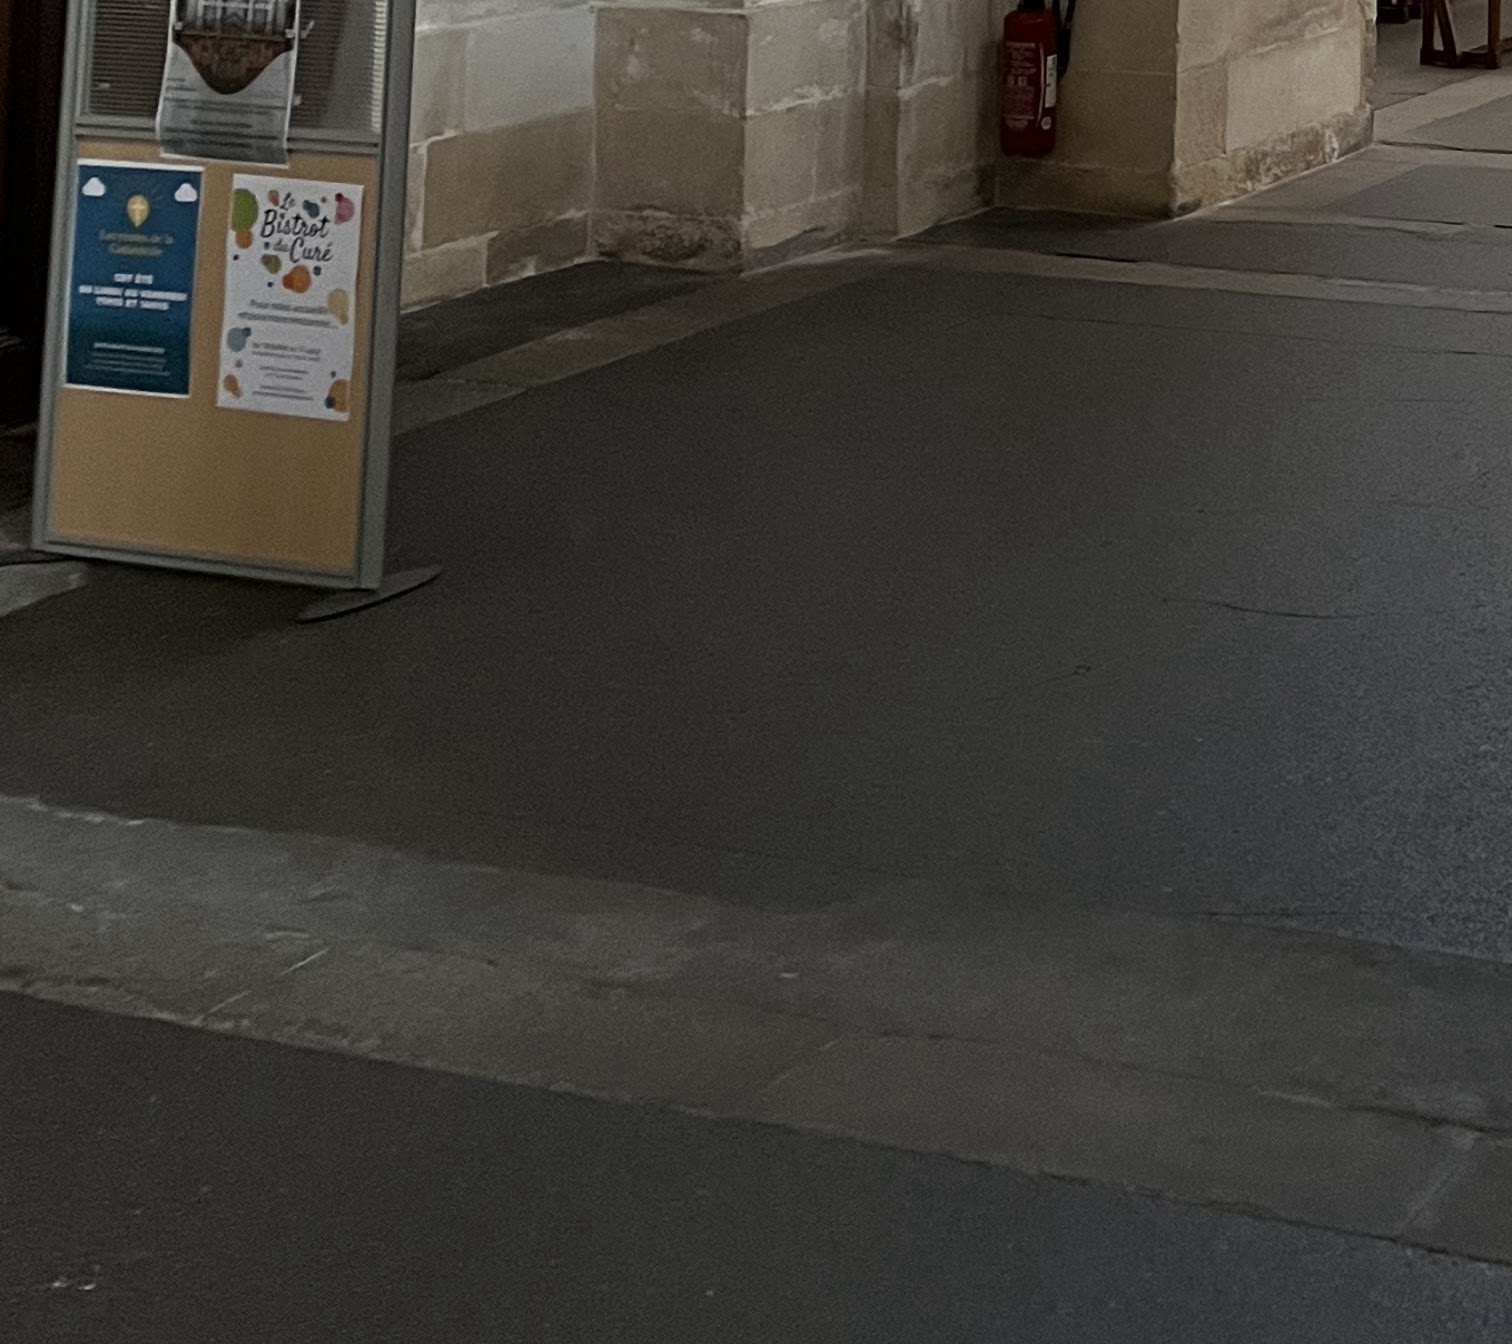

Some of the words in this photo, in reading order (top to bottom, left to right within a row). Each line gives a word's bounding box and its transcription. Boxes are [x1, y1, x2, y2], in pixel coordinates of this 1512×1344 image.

[280, 192, 296, 211] Le
[260, 208, 330, 239] Bistrot
[290, 236, 334, 264] Curé
